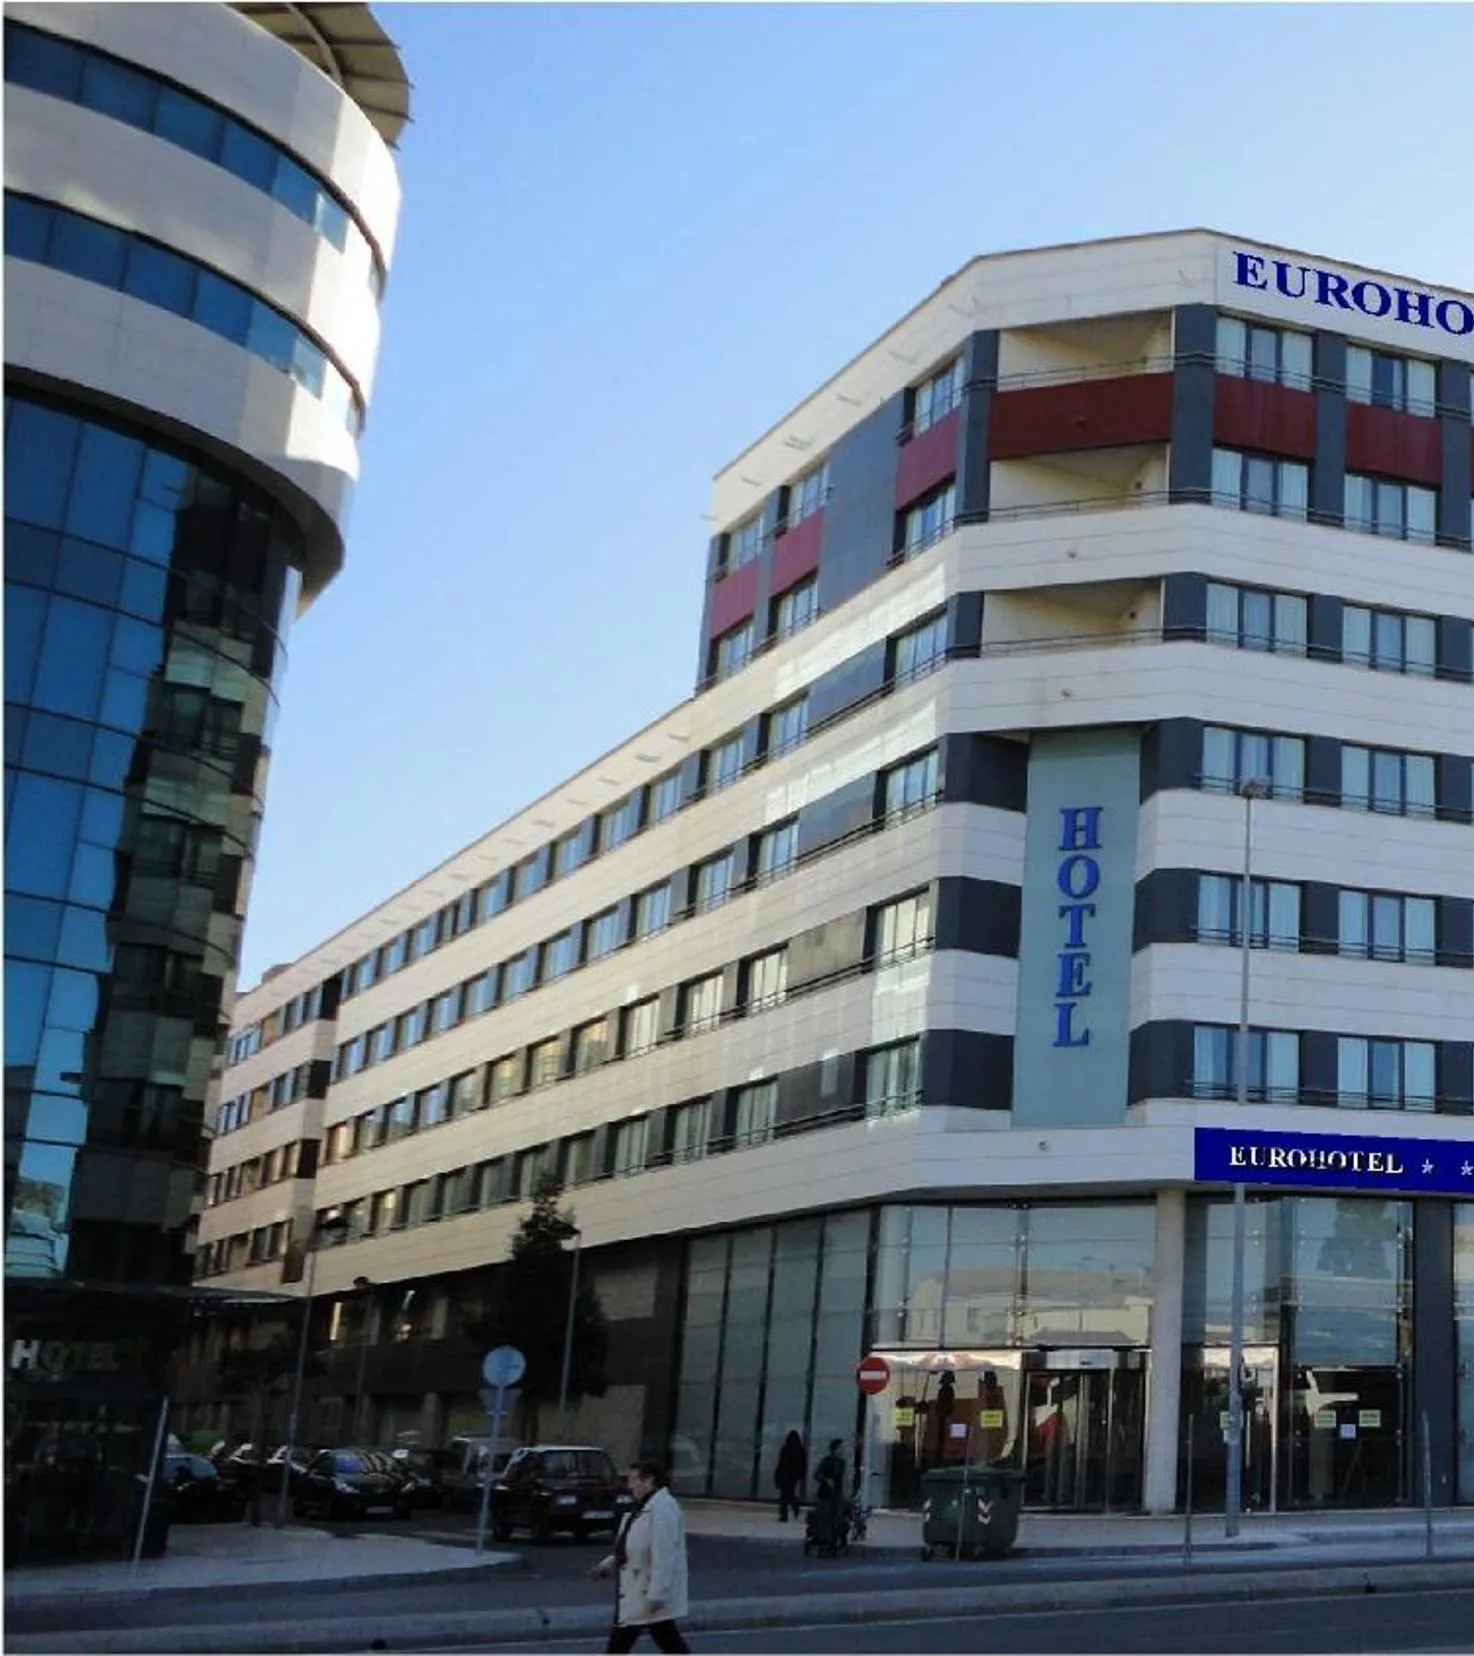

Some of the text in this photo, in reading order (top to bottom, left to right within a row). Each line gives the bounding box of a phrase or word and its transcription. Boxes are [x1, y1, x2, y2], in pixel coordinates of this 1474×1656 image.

[1053, 806, 1104, 1048] HOTEL
[1229, 1146, 1404, 1174] EUROHOTEL
[11, 1339, 120, 1372] HOTEL
